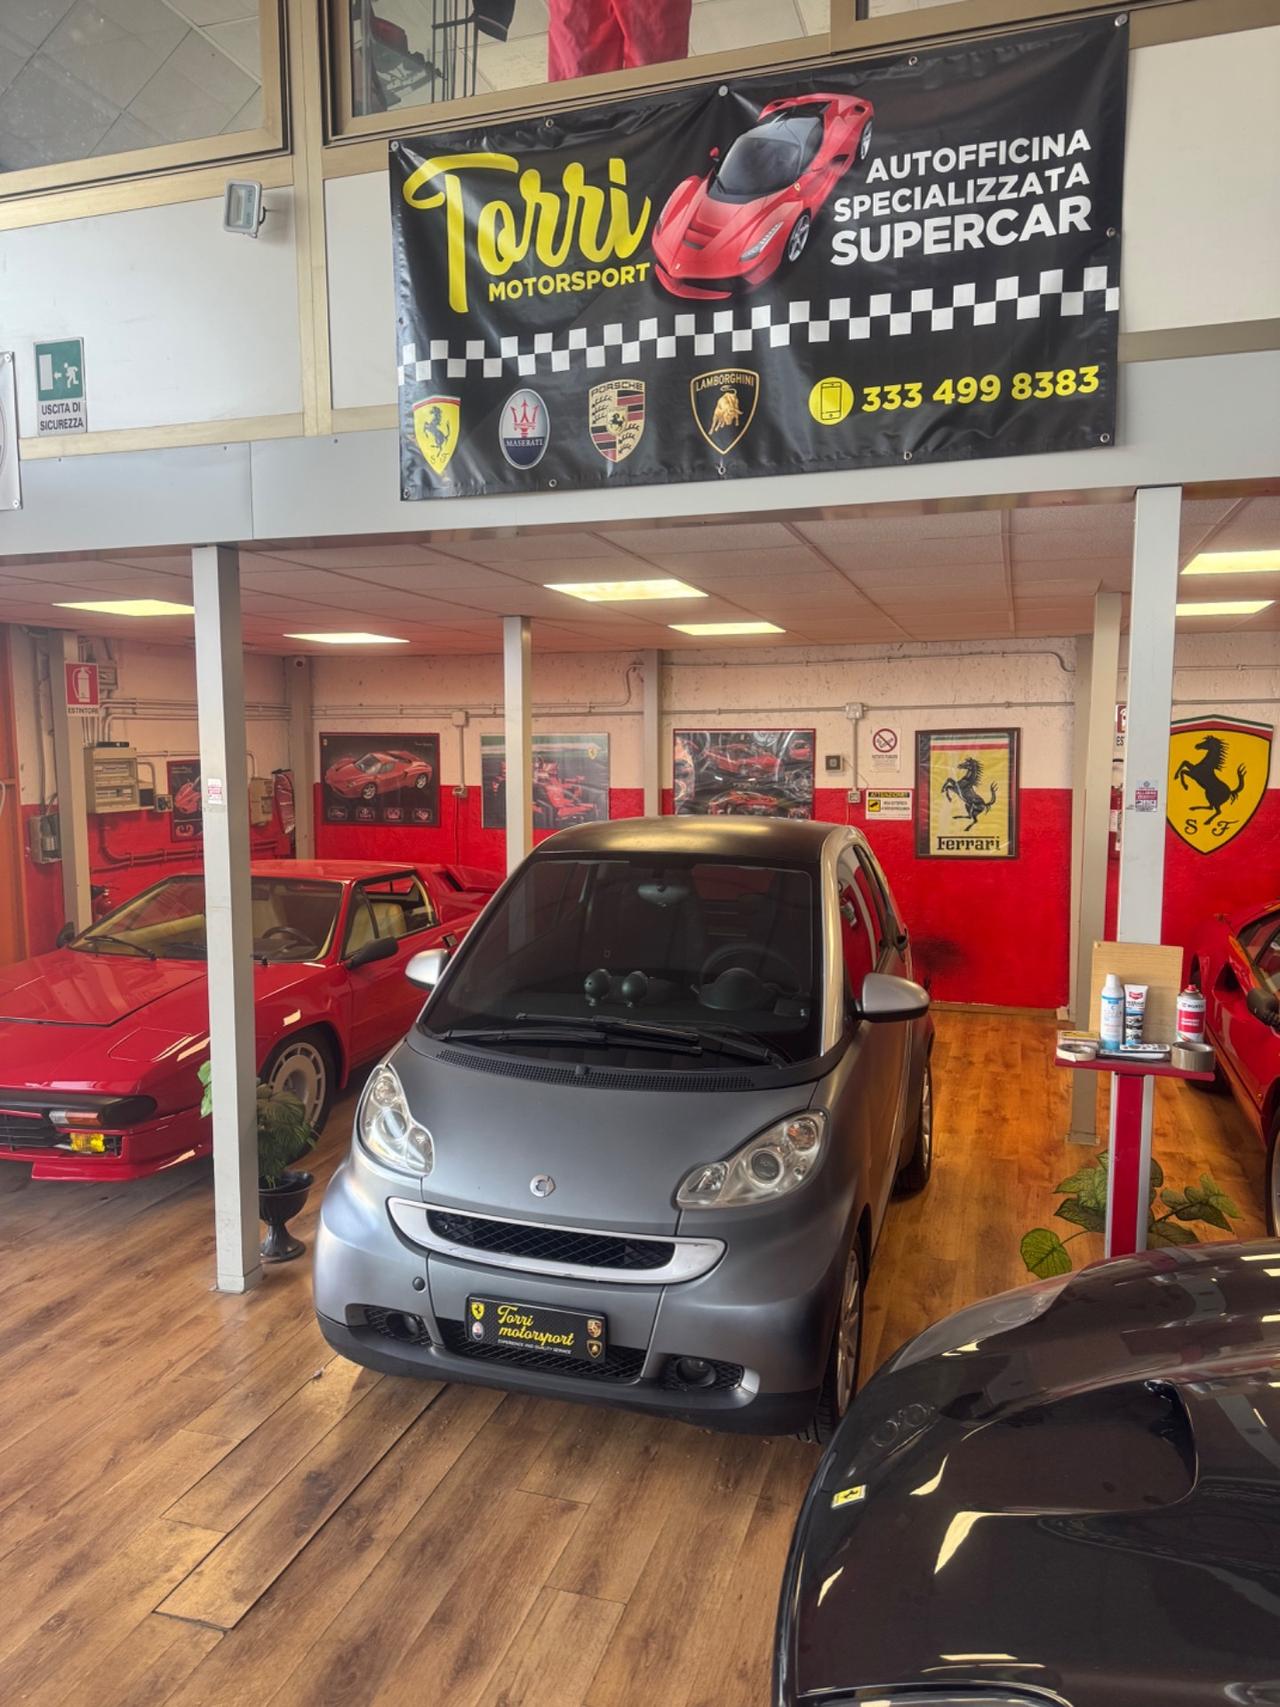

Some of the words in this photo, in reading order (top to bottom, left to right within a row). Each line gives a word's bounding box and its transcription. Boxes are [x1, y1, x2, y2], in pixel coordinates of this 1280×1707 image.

[866, 128, 1091, 183] AUTOFFICINA
[833, 162, 1090, 222] SPECIALIZZATA
[403, 152, 651, 313] Torri
[830, 195, 1092, 266] SUPERCAR
[488, 262, 651, 302] MOTORSPORT
[591, 382, 643, 397] PORSCHE
[696, 373, 754, 392] LAMBORGHINI
[861, 382, 923, 412] 333
[932, 374, 1001, 404] 499
[1011, 365, 1099, 400] 8383
[41, 403, 71, 415] USCITA
[72, 402, 81, 412] DI
[40, 417, 84, 431] SICUREZZA
[506, 439, 545, 447] MASERATI
[1184, 819, 1198, 835] S
[1211, 820, 1240, 836] F
[937, 836, 1001, 850] Ferrari
[497, 1305, 535, 1326] Torri
[498, 1326, 575, 1346] motorsport
